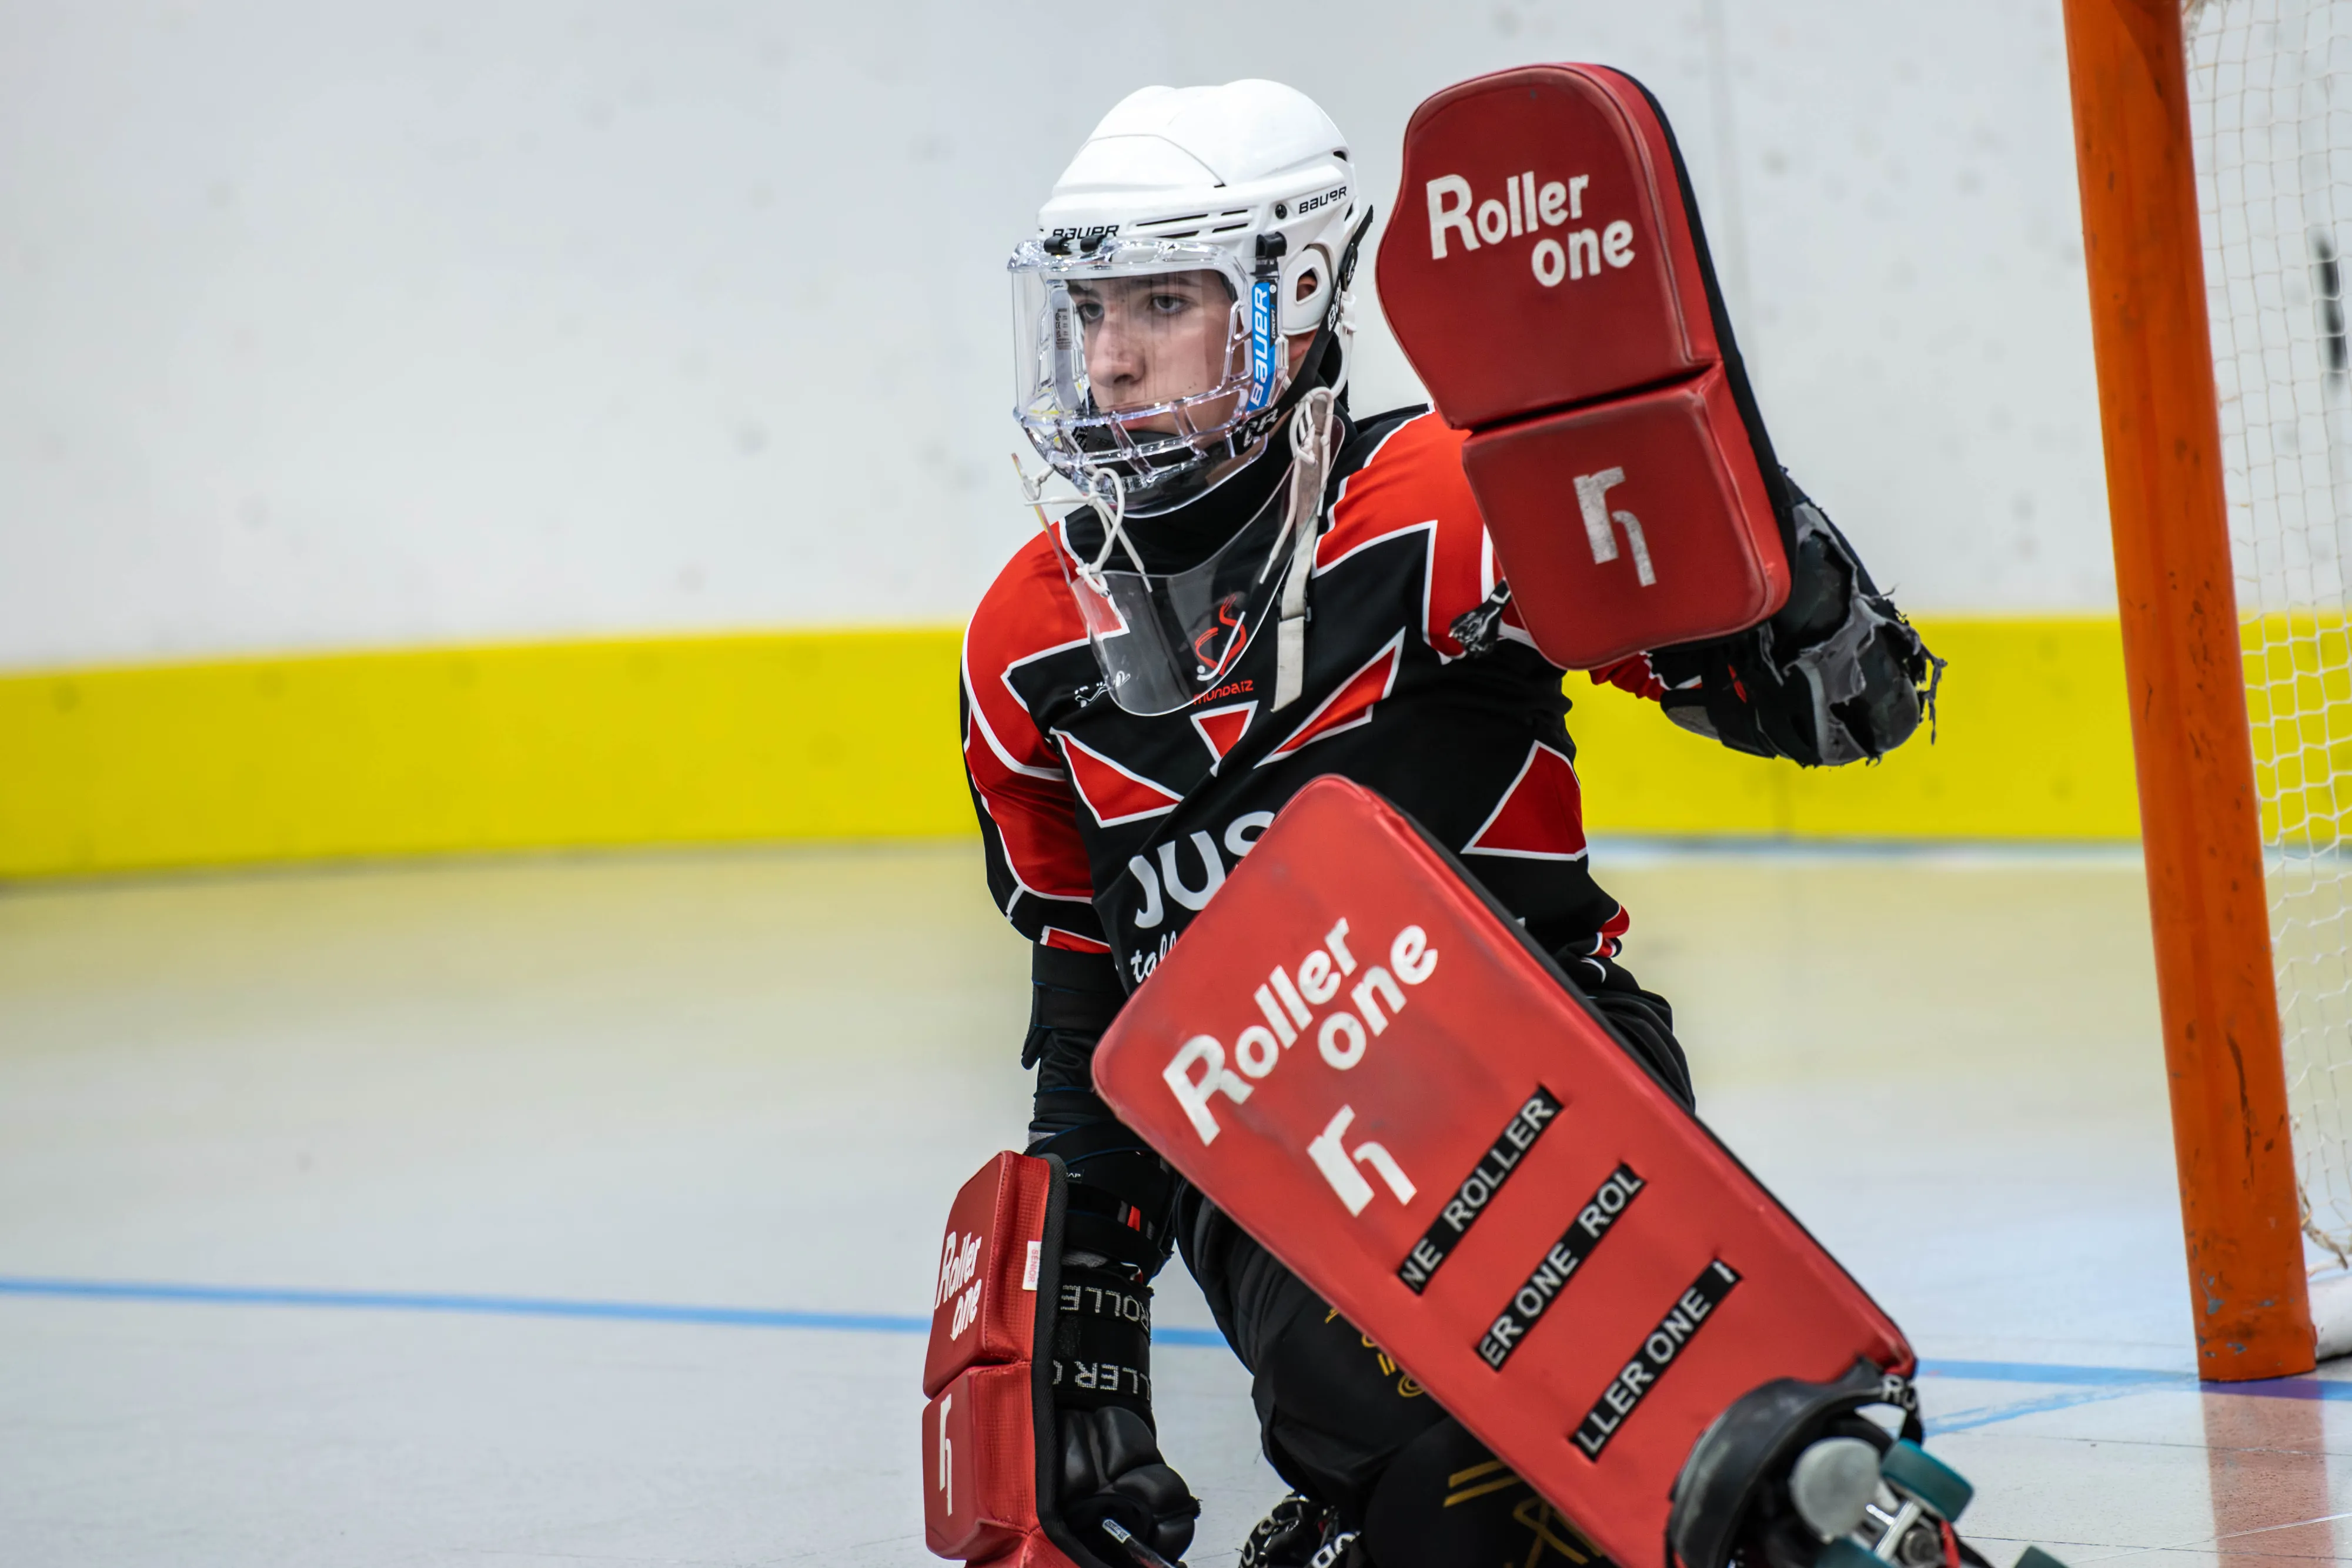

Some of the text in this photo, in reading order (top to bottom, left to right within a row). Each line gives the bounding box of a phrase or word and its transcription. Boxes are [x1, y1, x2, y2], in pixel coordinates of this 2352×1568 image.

[1299, 186, 1347, 215] BAUER
[1426, 171, 1589, 260] Roller
[1532, 220, 1635, 287] one
[1250, 286, 1268, 407] BAUER
[1162, 917, 1357, 1147] Roller
[1317, 925, 1438, 1070] one
[1442, 1097, 1553, 1232] ROLLER
[934, 1231, 982, 1310] Roller
[950, 1279, 982, 1341] one
[1479, 1315, 1524, 1367] ER
[1515, 1243, 1578, 1316] ONE
[1576, 1287, 1712, 1452] LLER ONE
